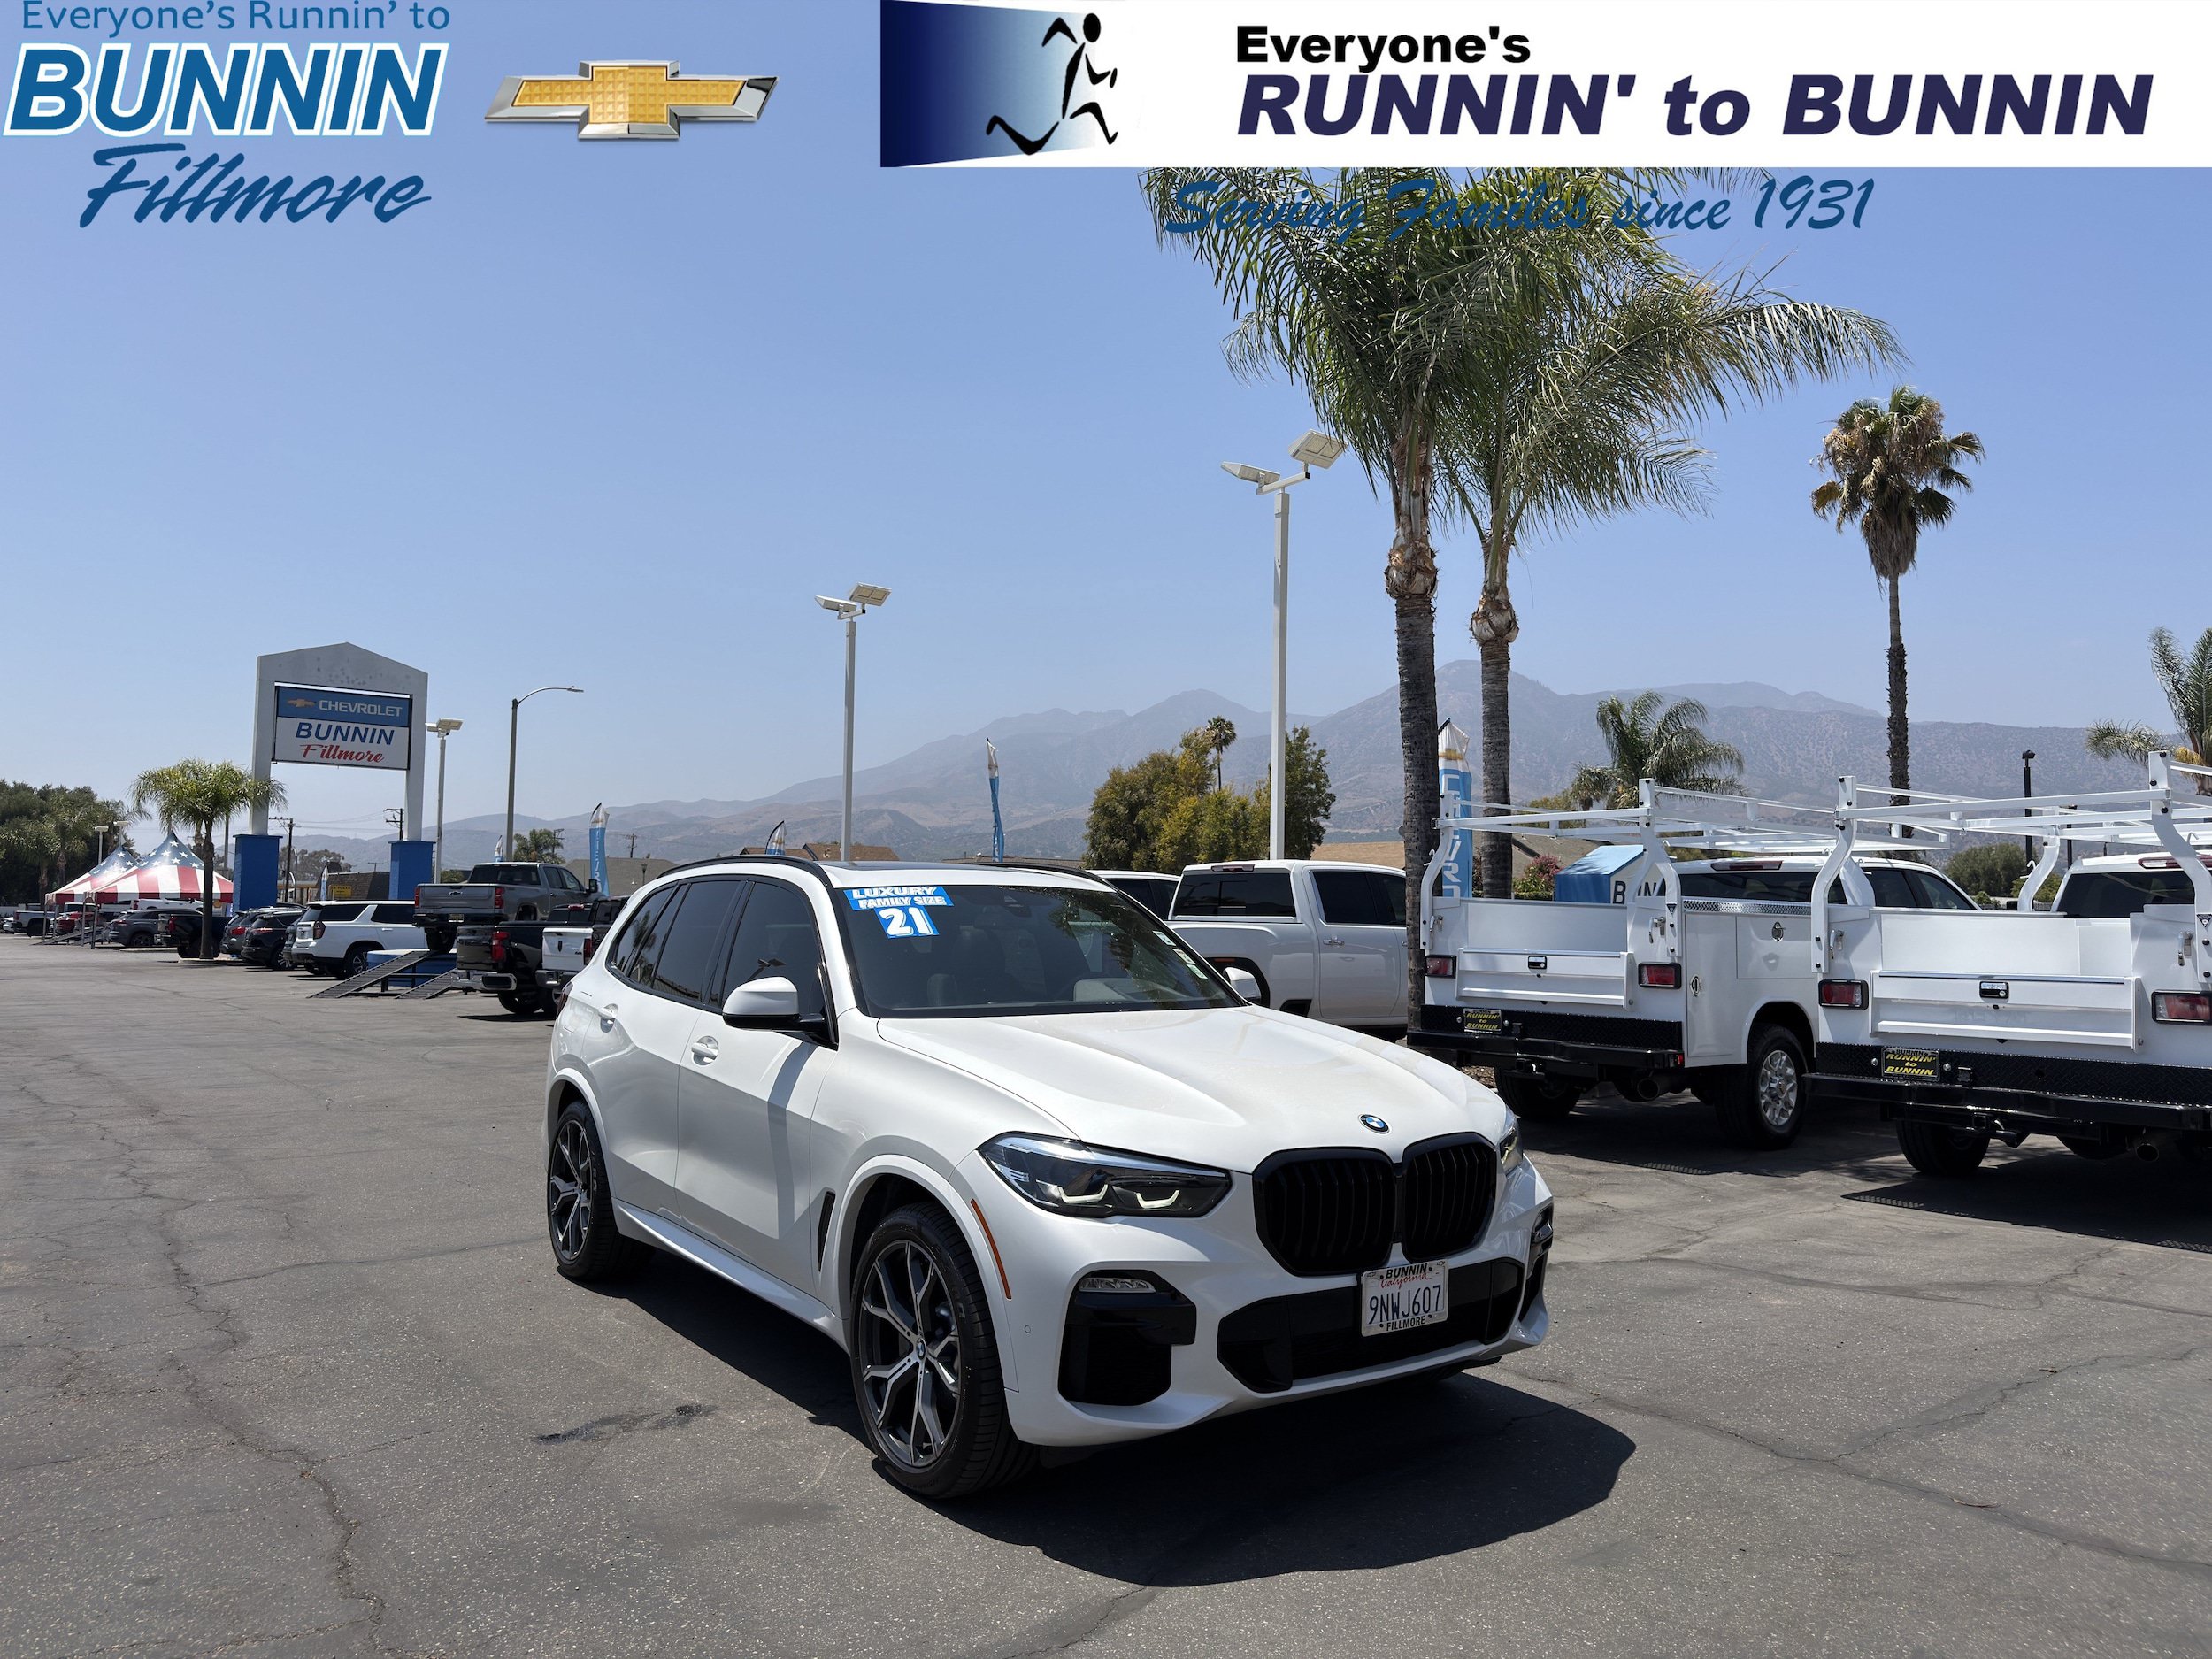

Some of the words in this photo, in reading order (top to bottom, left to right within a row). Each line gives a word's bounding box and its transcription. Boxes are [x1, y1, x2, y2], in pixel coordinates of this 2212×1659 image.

[319, 699, 403, 718] CHEVROLET
[295, 722, 395, 745] BUNNIN
[299, 744, 386, 763] Fillmore
[852, 886, 938, 899] LUXURY
[858, 896, 912, 909] FAMILY
[914, 895, 947, 906] SIZE
[879, 906, 934, 936] 21
[1886, 1054, 1936, 1063] RUNNIN'
[1886, 1065, 1934, 1075] BUNNIN
[1385, 1263, 1428, 1279] BUNNIN
[1368, 1284, 1441, 1325] 9NWJ607
[1386, 1315, 1426, 1332] FILLMORE
